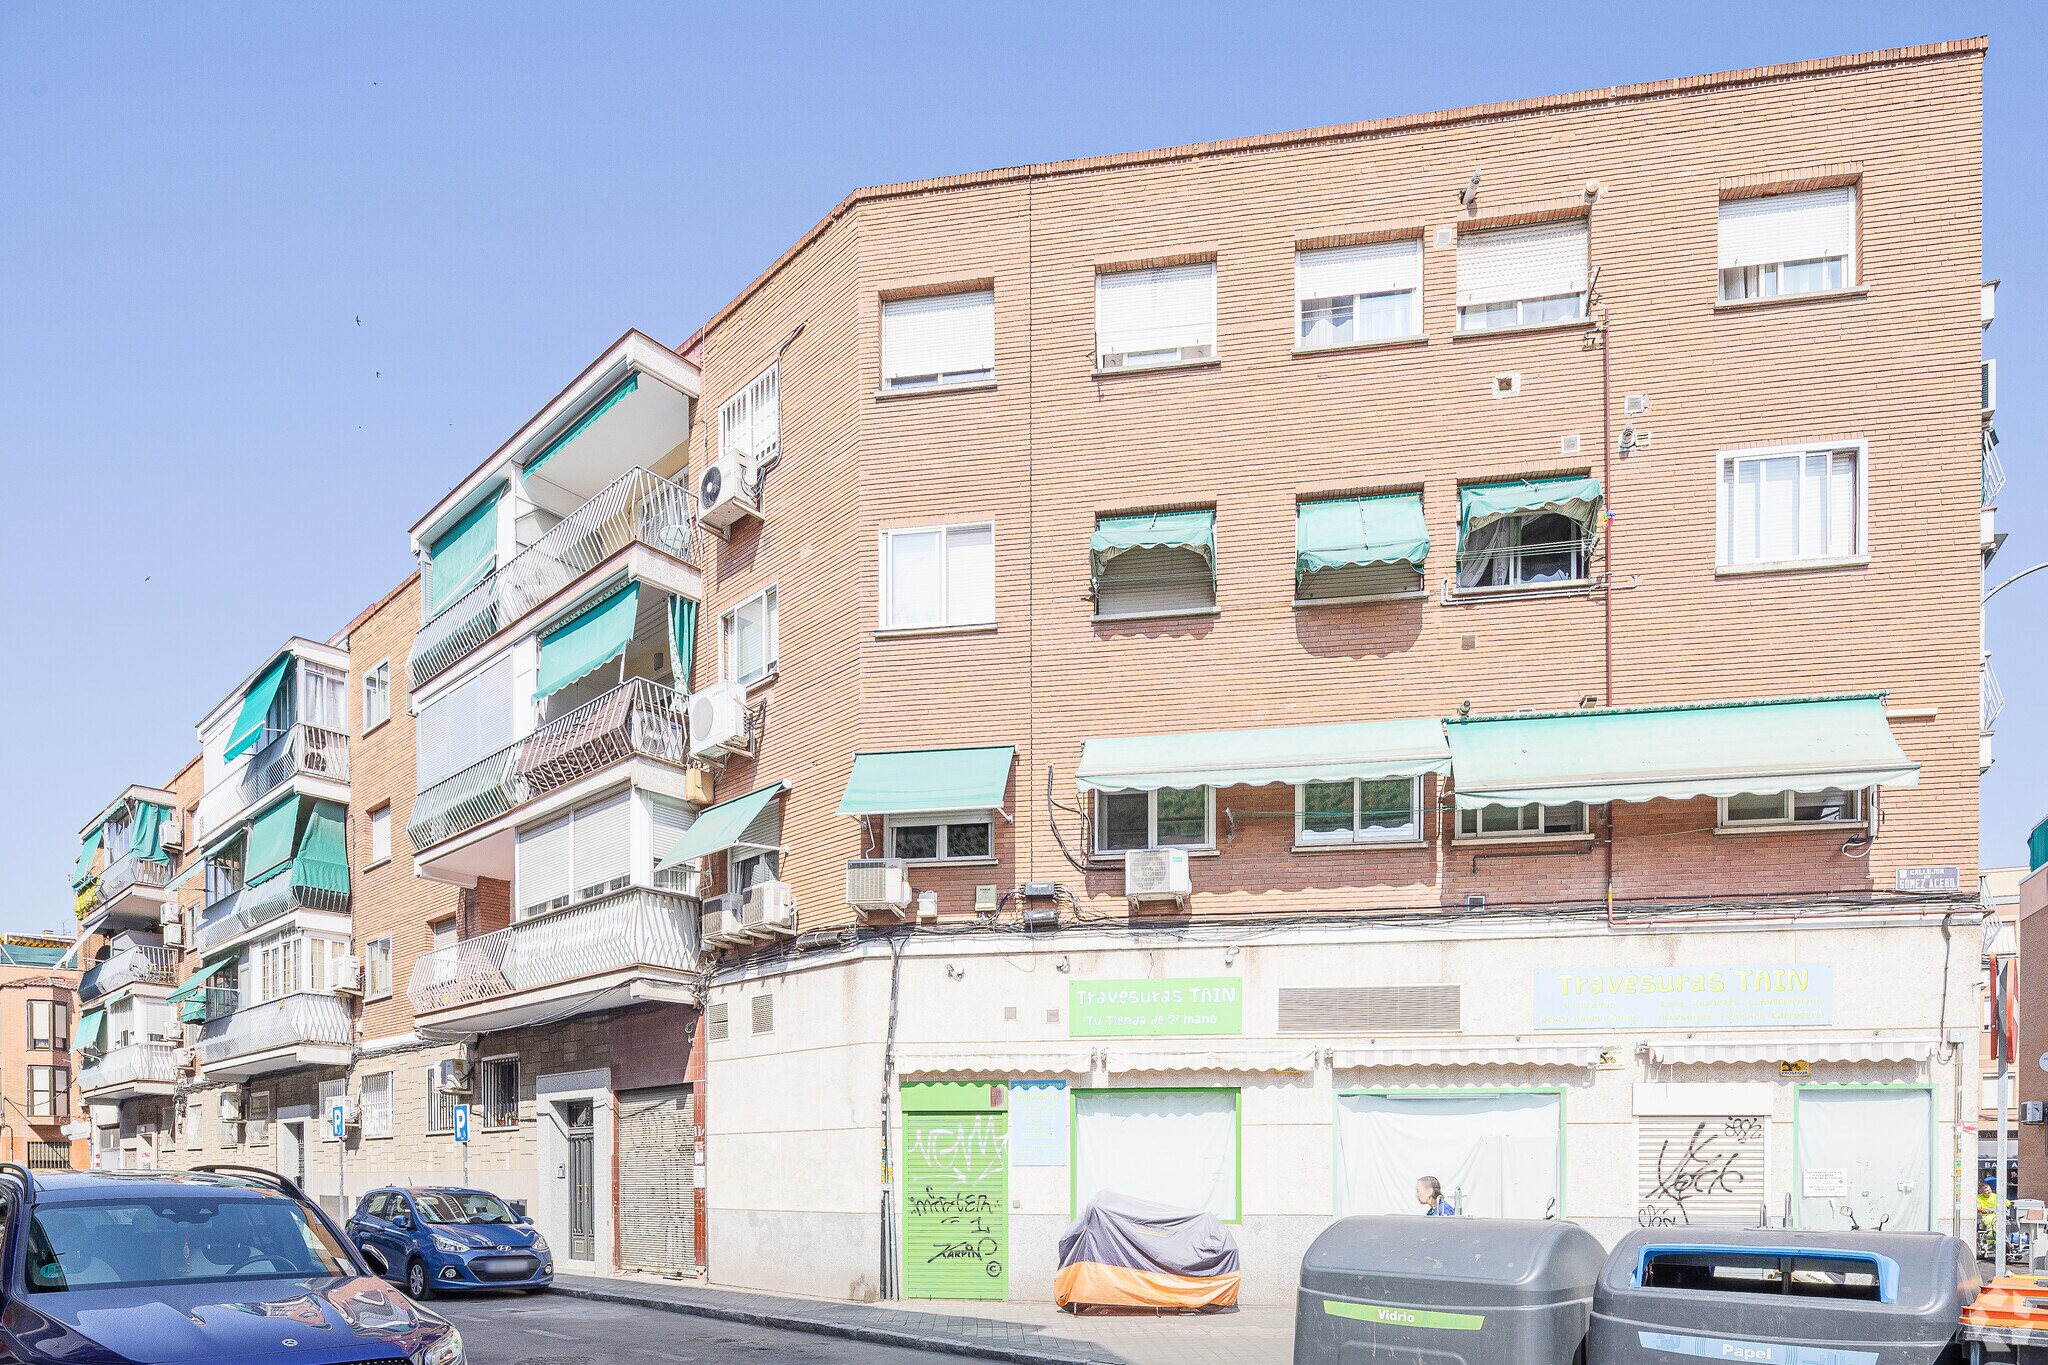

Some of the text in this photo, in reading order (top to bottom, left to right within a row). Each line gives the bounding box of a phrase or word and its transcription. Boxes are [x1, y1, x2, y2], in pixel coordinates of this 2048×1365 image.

[1928, 877, 1956, 888] ACEBO
[1556, 968, 1809, 996] Travesuras TAIN
[1076, 987, 1236, 1005] Travesuras TAIN
[1087, 1016, 1100, 1026] Tu
[1106, 1015, 1147, 1026] Tienda
[1150, 1014, 1165, 1025] de
[1183, 1014, 1218, 1025] mano
[456, 1109, 466, 1138] P
[1378, 1309, 1415, 1323] Vidrio
[1722, 1343, 1772, 1360] Papel
